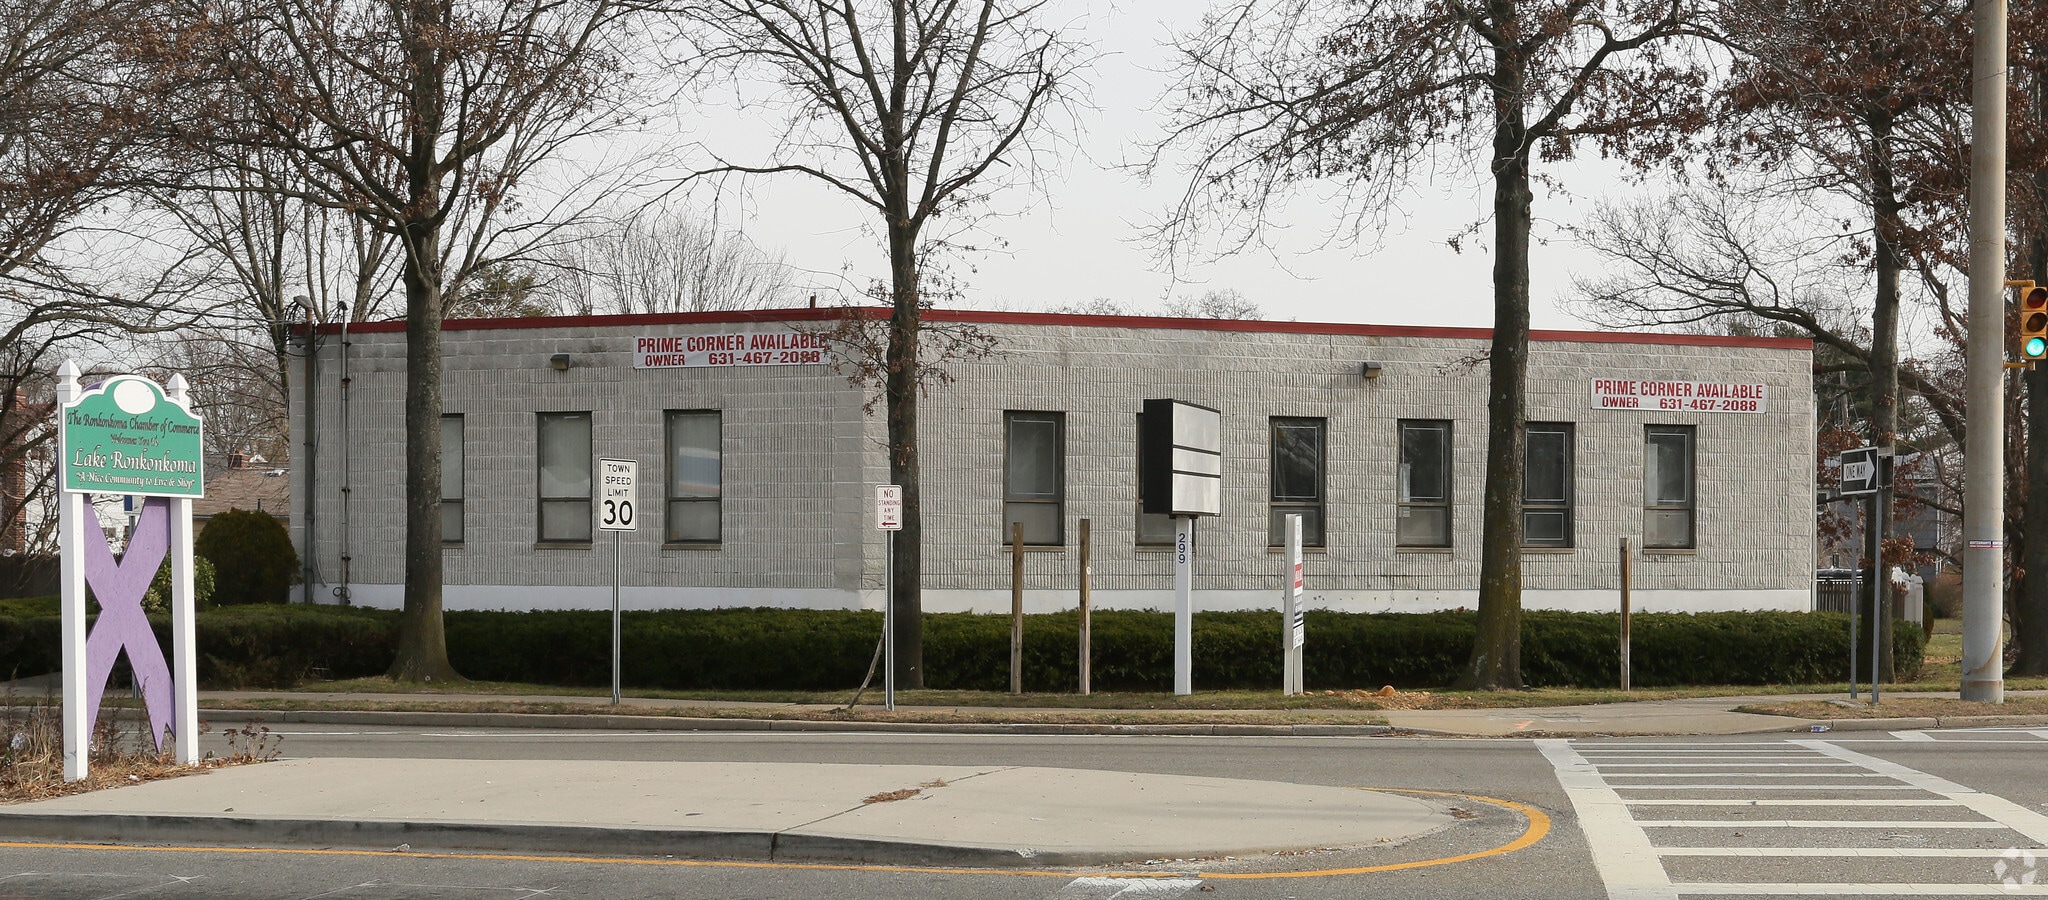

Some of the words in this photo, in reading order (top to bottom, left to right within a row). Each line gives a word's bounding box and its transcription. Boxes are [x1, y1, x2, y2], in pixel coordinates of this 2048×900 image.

[638, 338, 683, 353] PRIME
[687, 335, 745, 352] CORNER
[751, 333, 826, 350] AVAILABLE
[645, 354, 685, 367] OWNER
[708, 351, 821, 365] 631-467-2088
[1595, 380, 1636, 395] PRIME
[1641, 381, 1692, 397] CORNER
[1697, 383, 1763, 399] AVAILABLE
[1602, 396, 1639, 408] OWNER
[1659, 398, 1757, 412] 631-467-2088
[67, 409, 82, 425] The
[83, 412, 128, 430] Ronkonkoma
[129, 415, 159, 432] Chamber
[160, 418, 168, 439] of
[168, 421, 200, 434] Commerce
[72, 445, 107, 468] Lake
[110, 448, 197, 474] Ronkonkoma
[607, 464, 630, 473] TOWN
[86, 469, 104, 483] Nice
[104, 472, 144, 490] Community
[145, 477, 153, 485] to
[153, 475, 168, 487] Live
[168, 477, 176, 487] &
[605, 476, 632, 485] SPEED
[1845, 465, 1856, 480] ONE
[1856, 463, 1866, 478] WAY
[607, 488, 629, 497] LIMIT
[883, 489, 894, 498] NO
[603, 500, 633, 525] 30
[1178, 533, 1186, 564] 299
